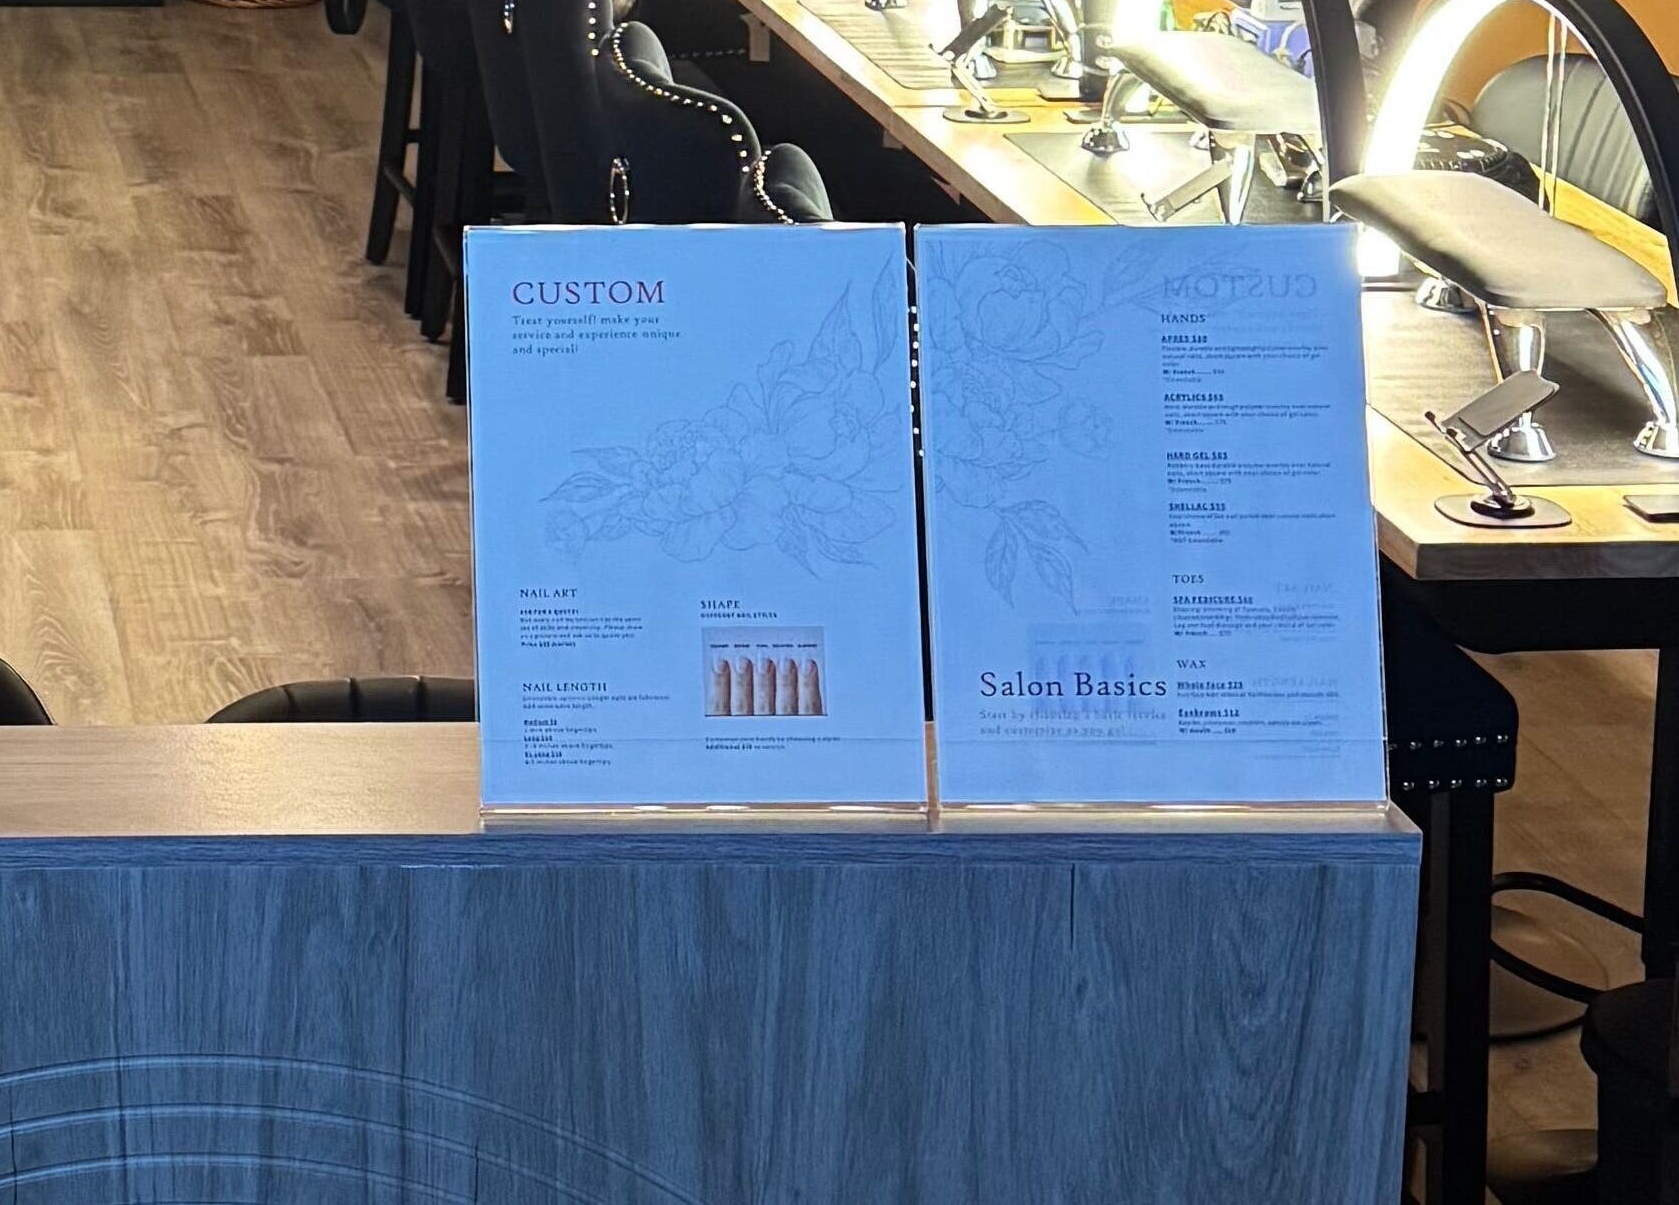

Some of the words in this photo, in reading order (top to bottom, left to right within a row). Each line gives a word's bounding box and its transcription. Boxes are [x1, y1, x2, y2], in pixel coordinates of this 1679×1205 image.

[513, 280, 665, 305] CUSTOM
[1161, 314, 1207, 324] HANDS
[555, 330, 574, 340] and
[578, 331, 638, 342] experience
[512, 345, 533, 355] and
[1172, 574, 1204, 584] TOES
[520, 588, 550, 598] NAIL
[553, 588, 577, 598] ART
[700, 599, 740, 609] SHAPE
[1176, 659, 1207, 669] WAX
[523, 683, 553, 692] NAIL
[557, 682, 607, 692] LENGTH
[980, 671, 1064, 697] Salon
[1074, 672, 1167, 697] Basics
[980, 725, 1001, 735] and
